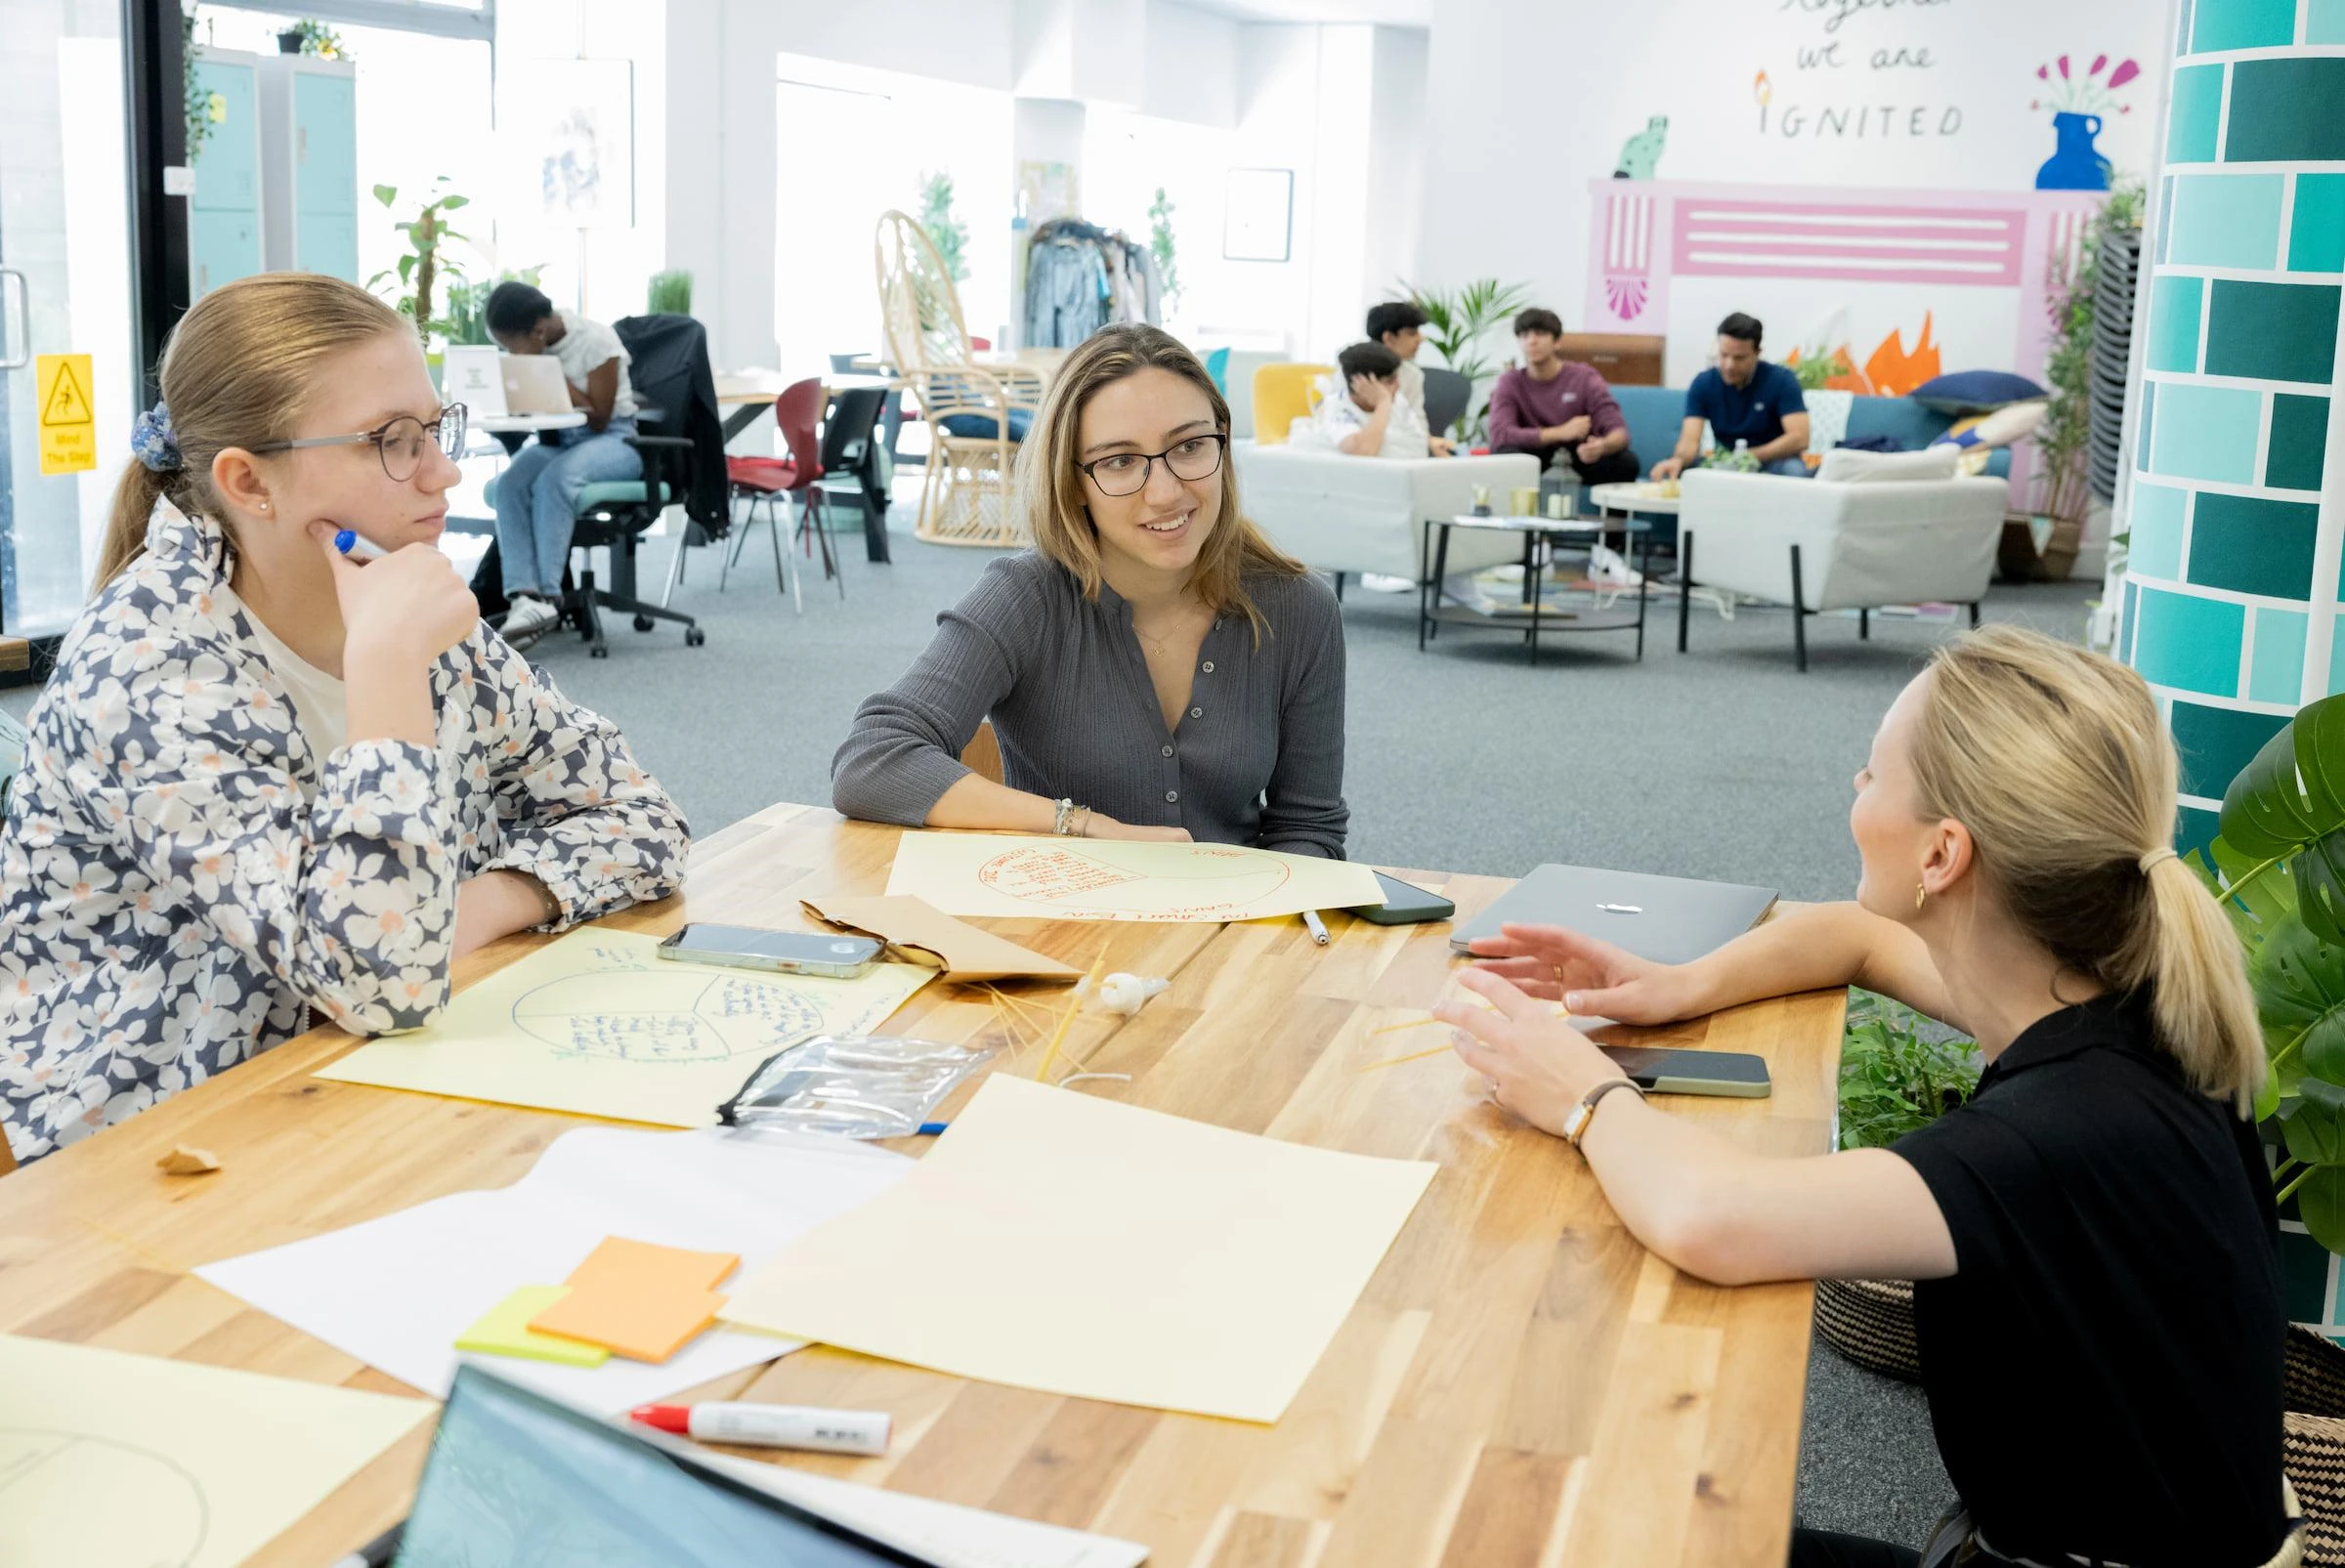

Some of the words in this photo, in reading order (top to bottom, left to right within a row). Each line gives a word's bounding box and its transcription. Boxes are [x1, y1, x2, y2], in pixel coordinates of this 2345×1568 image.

[1796, 41, 1846, 69] we
[1759, 103, 1964, 139] IGNITED
[56, 434, 81, 445] Mind
[47, 452, 65, 465] The
